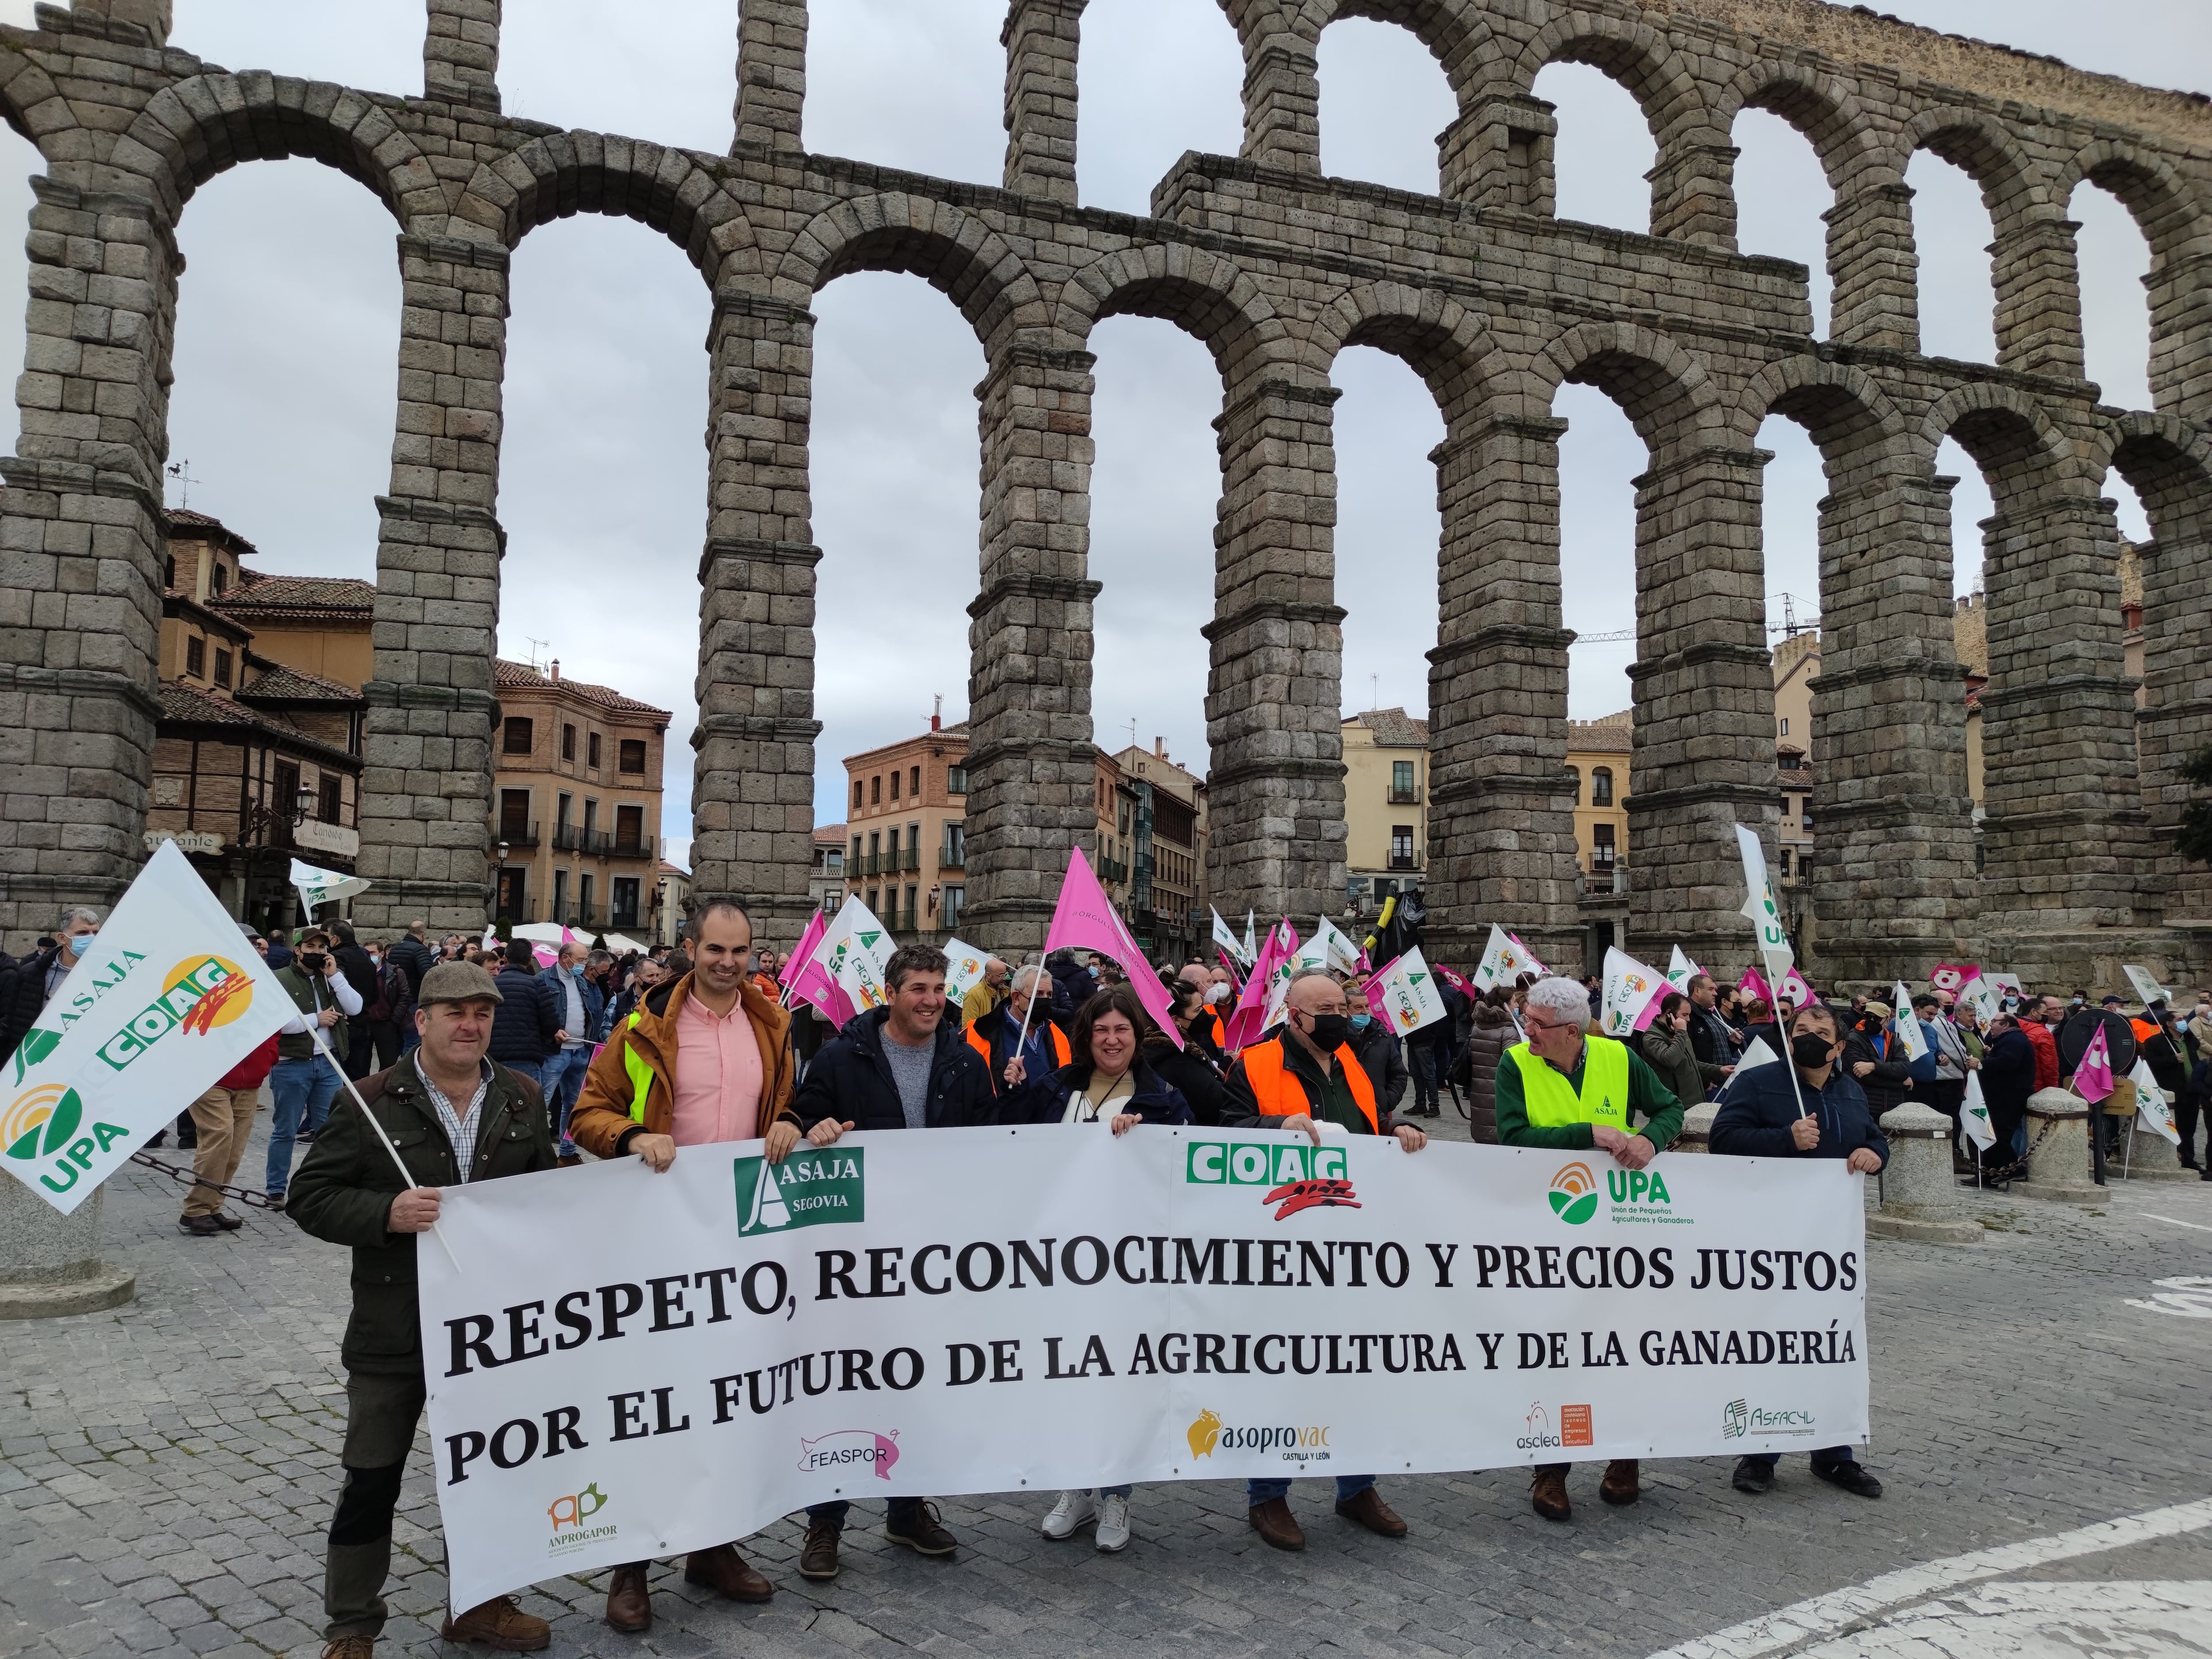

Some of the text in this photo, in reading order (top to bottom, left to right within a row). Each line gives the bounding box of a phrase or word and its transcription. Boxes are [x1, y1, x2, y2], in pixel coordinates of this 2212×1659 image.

[1765, 926, 1786, 945] UP
[869, 951, 885, 979] ASAJ
[956, 959, 974, 982] COAG
[59, 950, 148, 1032] ASAJA
[955, 991, 967, 1004] UPA
[1414, 986, 1427, 1009] ASAJA
[1607, 975, 1619, 1000] ASAJA
[1618, 975, 1640, 1003] COAG
[96, 958, 234, 1071] COAG
[1398, 991, 1418, 1025] COAG
[1620, 1014, 1635, 1033] UPA
[1902, 1020, 1916, 1043] ASAJA
[40, 1122, 130, 1193] UPA
[1188, 1143, 1347, 1184] COAG
[780, 1159, 860, 1185] ASAJA
[1607, 1169, 1671, 1204] UPA
[793, 1194, 849, 1212] SEGOVIA
[1611, 1205, 1627, 1214] Unión
[1612, 1215, 1650, 1224] Agricultores
[444, 1235, 1857, 1378] RESPETO, RECONOCIMIENTO Y PRECIOS JUSTOS
[445, 1319, 1856, 1487] POR EL FUTURO DE LA AGRICULTURA Y DE LA GANADERÍA
[1751, 1408, 1815, 1426] ASFACYL
[1222, 1426, 1330, 1454] asoprovac
[1517, 1431, 1561, 1449] asclea
[811, 1448, 887, 1468] FEASPOR
[1316, 1450, 1330, 1460] LEÓN
[548, 1525, 617, 1548] ANPROGAPOR
